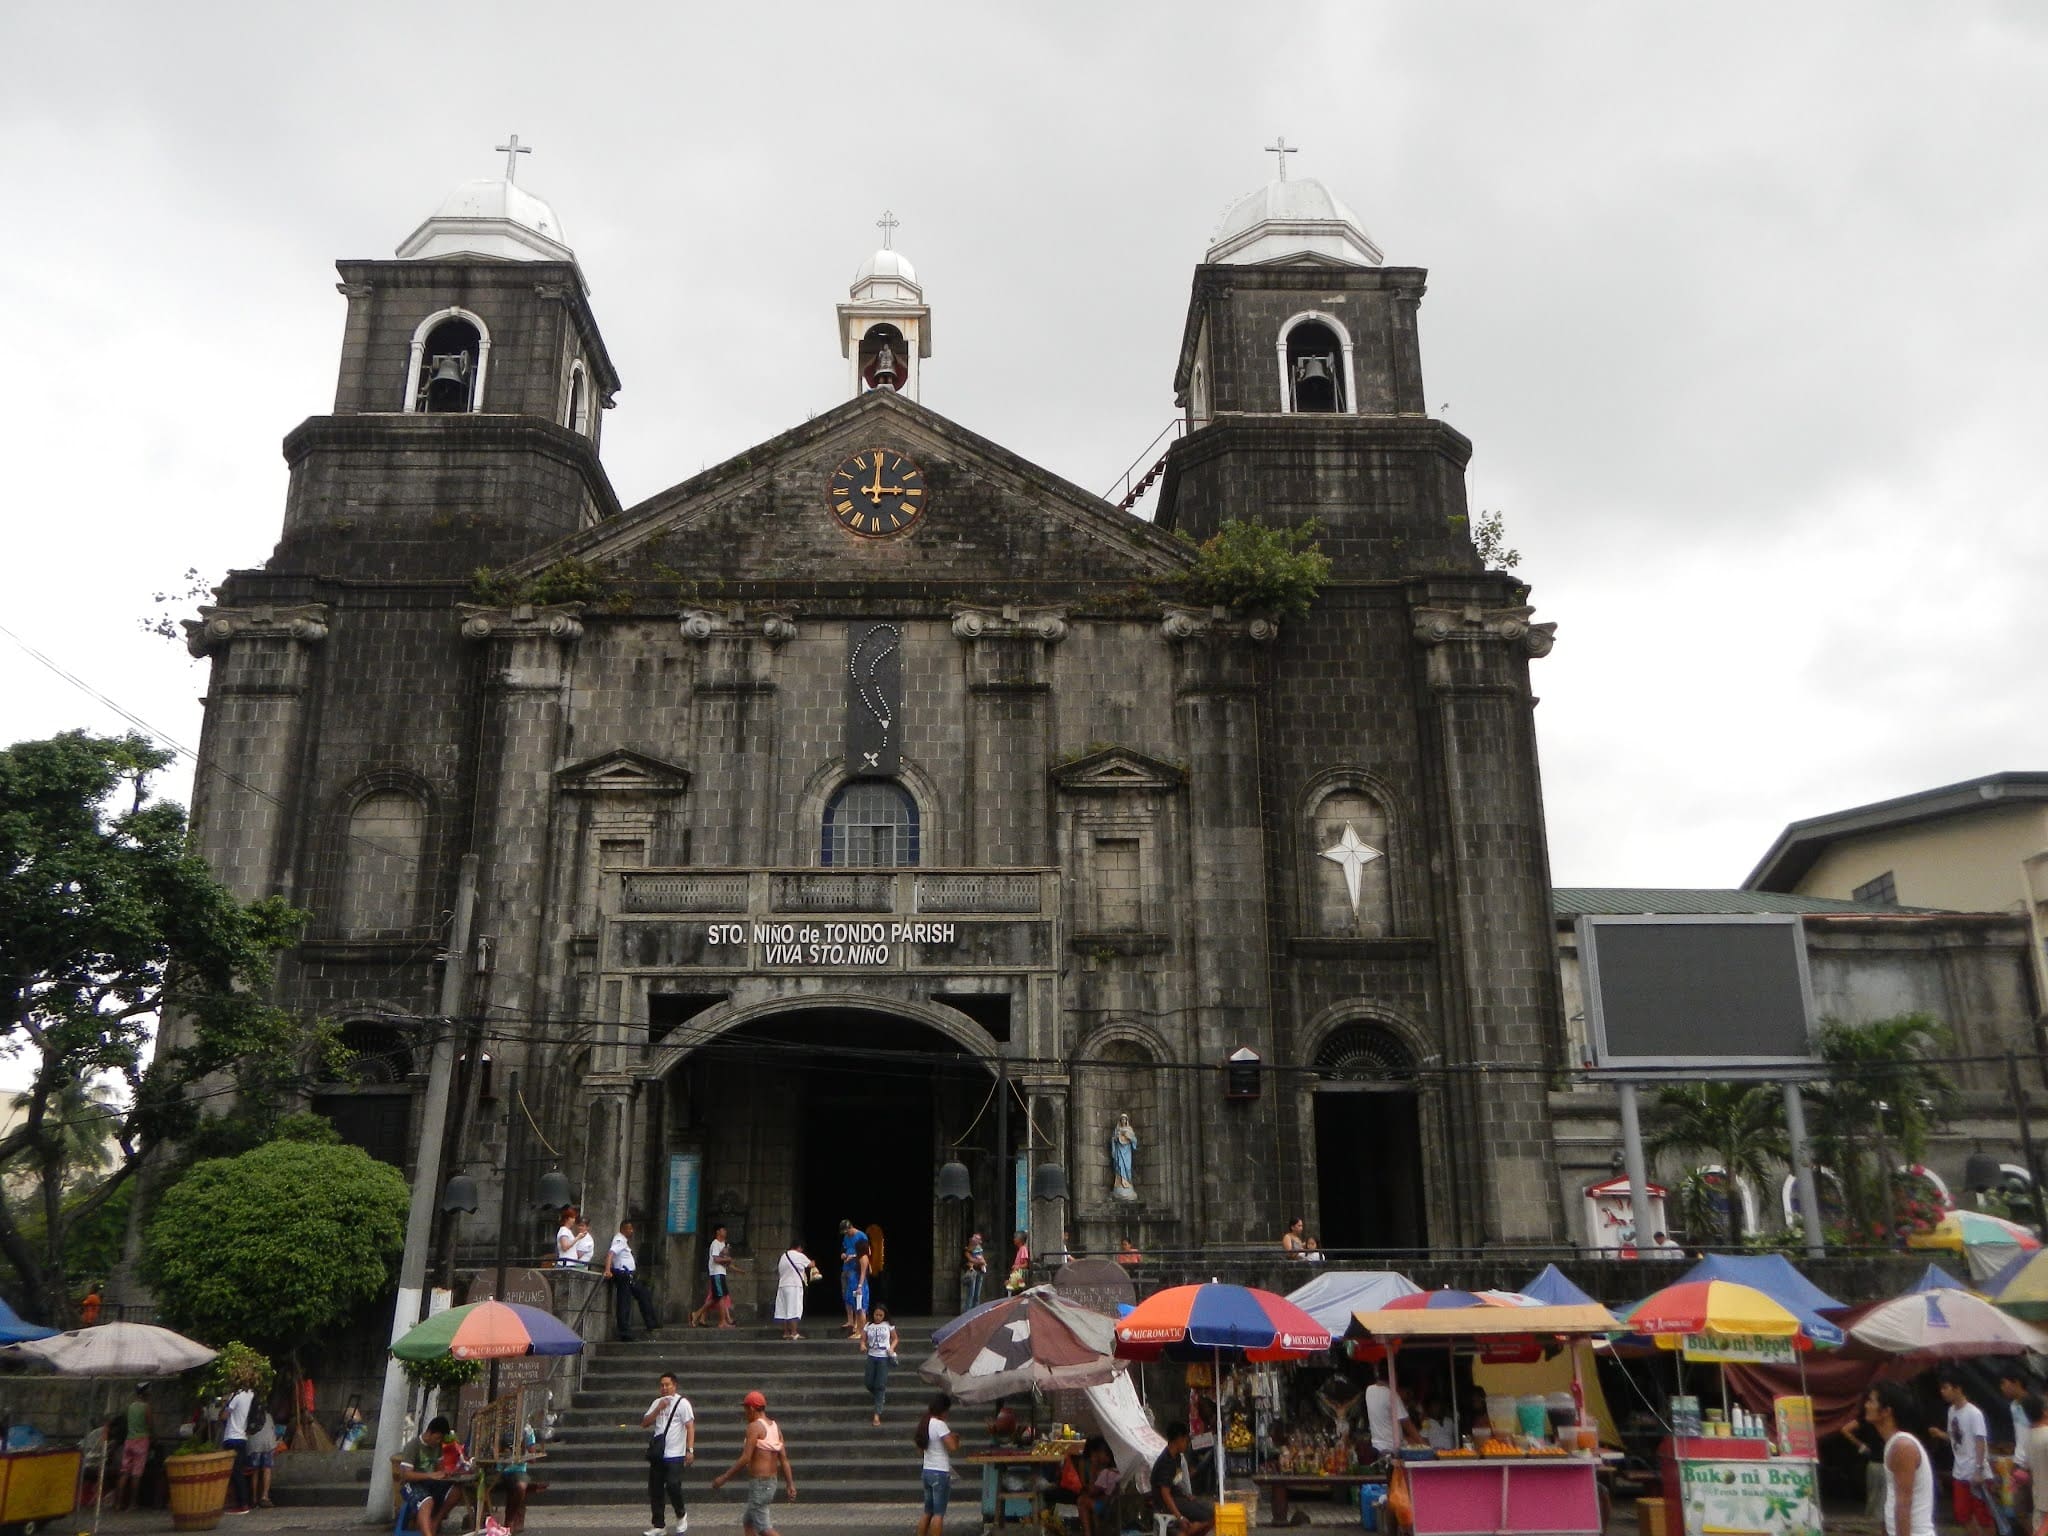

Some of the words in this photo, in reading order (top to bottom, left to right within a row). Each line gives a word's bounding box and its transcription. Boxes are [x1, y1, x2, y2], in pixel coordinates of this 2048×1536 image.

[708, 924, 747, 944] STO.
[753, 924, 794, 944] NIÑO
[800, 924, 820, 944] de
[824, 923, 885, 943] TONDO
[891, 923, 955, 943] PARISH
[765, 944, 802, 964] VIVA
[1131, 1328, 1182, 1339] MICROMATIC
[1292, 1335, 1329, 1346] MICROMATIC
[470, 1344, 525, 1354] MICROMATIC
